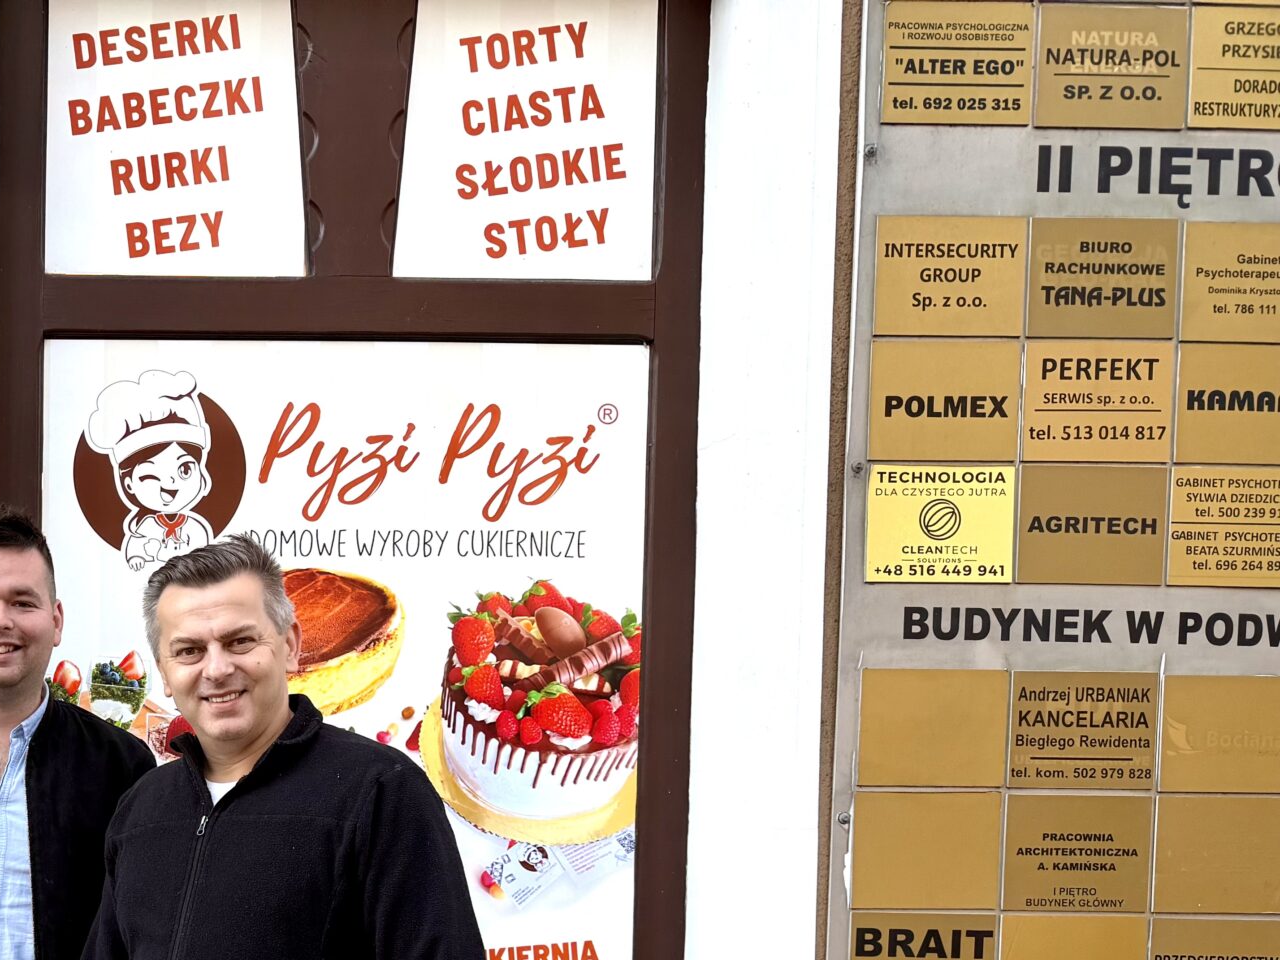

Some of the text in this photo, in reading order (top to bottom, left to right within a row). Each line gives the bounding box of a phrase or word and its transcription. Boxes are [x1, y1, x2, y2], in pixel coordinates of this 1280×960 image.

[888, 22, 1029, 31] PRACOWNIA PSYCHOLOGICZNA
[72, 13, 242, 70] DESERKI
[907, 32, 1015, 41] ROZWOJU OSOBISTEGO
[459, 21, 589, 73] TORTY
[1046, 47, 1180, 67] NATURA-POL
[895, 58, 1025, 76] "ALTER EGO"
[1120, 85, 1162, 101] O.O.
[68, 76, 265, 136] BABECZKI
[461, 83, 605, 137] CIASTA
[892, 97, 1021, 111] tel. 692 025 315
[109, 145, 231, 196] RURKI
[455, 142, 627, 201] SŁODKIE
[1036, 144, 1280, 209] II PIĘTR
[125, 211, 224, 259] BEZY
[483, 207, 610, 260] STOŁY
[884, 242, 1019, 260] INTERSECURITY
[1080, 241, 1133, 254] BIURO
[919, 267, 982, 284] GROUP
[1044, 262, 1166, 276] RACHUNKOWE
[1040, 285, 1166, 307] TANA-PLUS
[1208, 286, 1248, 295] Dominika
[955, 295, 988, 308] o.o.
[1213, 304, 1230, 314] tel.
[1041, 358, 1160, 381] PERFEKT
[884, 395, 1009, 418] POLMEX
[1043, 392, 1155, 405] SERWIS o.o.
[1186, 389, 1280, 412] KAMA
[1029, 425, 1166, 441] tel. 513 014 817
[258, 401, 600, 522] Pyzi Pyzi
[877, 471, 1006, 484] TECHNOLOGIA
[1175, 477, 1225, 489] GABINET
[902, 488, 1007, 497] CZYSTEGO JUTRA
[1186, 493, 1227, 503] SYLWIA
[1195, 507, 1214, 517] tel.
[1027, 515, 1158, 536] AGRITECH
[356, 529, 449, 558] WYROBY
[457, 530, 586, 559] CUKIERNICZE
[1171, 531, 1219, 541] GABINET
[901, 545, 978, 555] CLEANTECH
[1185, 545, 1219, 556] BEATA
[1192, 560, 1211, 570] tel.
[903, 606, 1165, 644] BUDYNEK W
[1018, 686, 1151, 706] Andrzej URBANIAK
[1018, 710, 1149, 729] KANCELARIA
[1015, 734, 1150, 750] Biegłego Rewidenta
[1011, 767, 1152, 779] tel. kom. 502 979 828
[1042, 832, 1114, 843] PRACOWNIA
[1016, 846, 1138, 858] ARCHITEKTONICZNA
[1053, 859, 1117, 872] KAMIŃSKA
[1059, 887, 1097, 898] PIĘTRO
[1025, 896, 1124, 908] BUDYNEK GŁÓWNY
[854, 927, 994, 960] BRAIT
